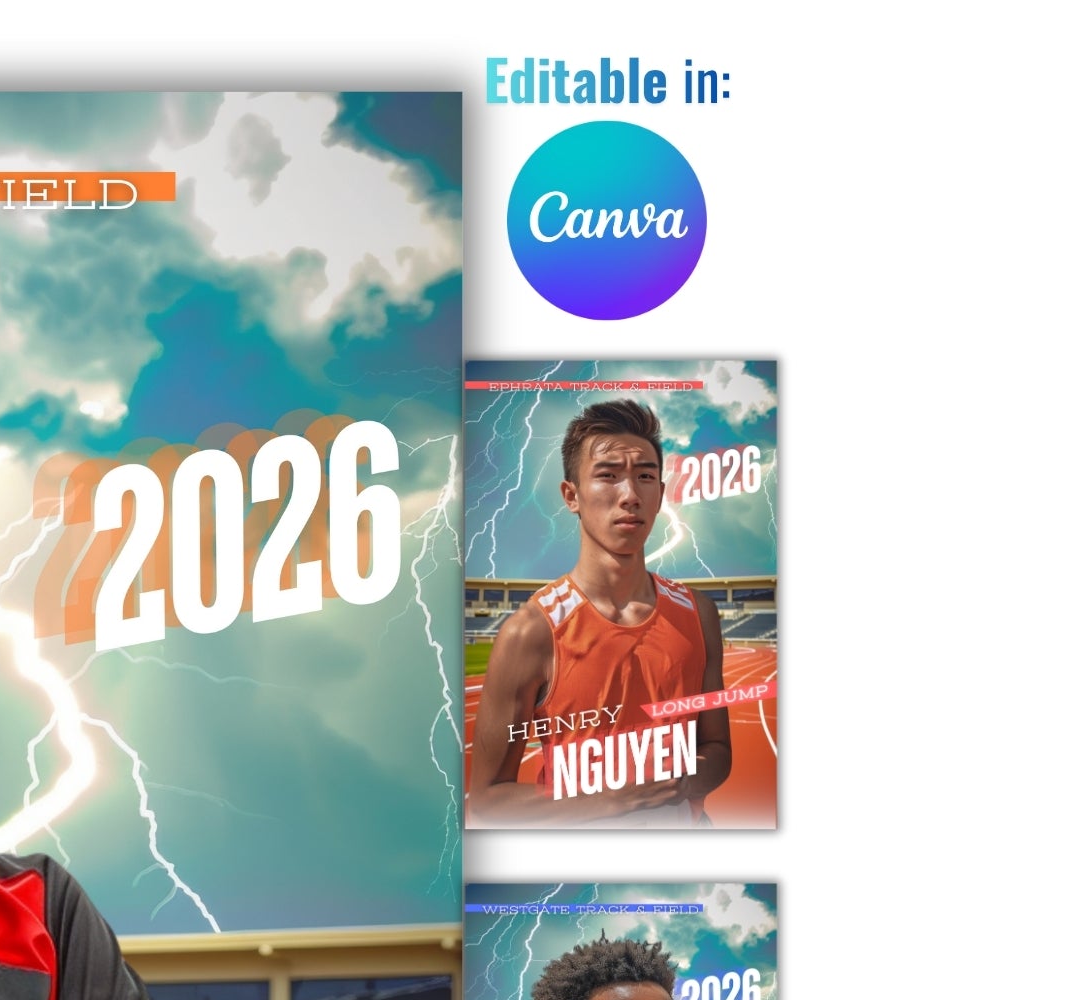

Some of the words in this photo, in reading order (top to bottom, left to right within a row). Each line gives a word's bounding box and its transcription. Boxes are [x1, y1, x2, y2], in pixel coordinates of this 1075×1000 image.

[486, 57, 667, 105] Editable
[685, 59, 730, 104] in:
[529, 190, 688, 243] Canva
[489, 382, 564, 391] EPHRATA
[570, 382, 624, 391] TRACK
[629, 382, 641, 391] &
[647, 382, 693, 391] FIELD
[681, 445, 761, 505] 2026
[94, 420, 401, 652] 2026
[507, 704, 623, 743] HENRY
[651, 696, 706, 717] LONG
[712, 684, 769, 705] JUMP
[553, 720, 697, 800] NGUYEN
[482, 905, 570, 915] WESTGATE
[576, 905, 629, 915] TRACK
[636, 905, 646, 915] &
[653, 905, 699, 915] FIELD
